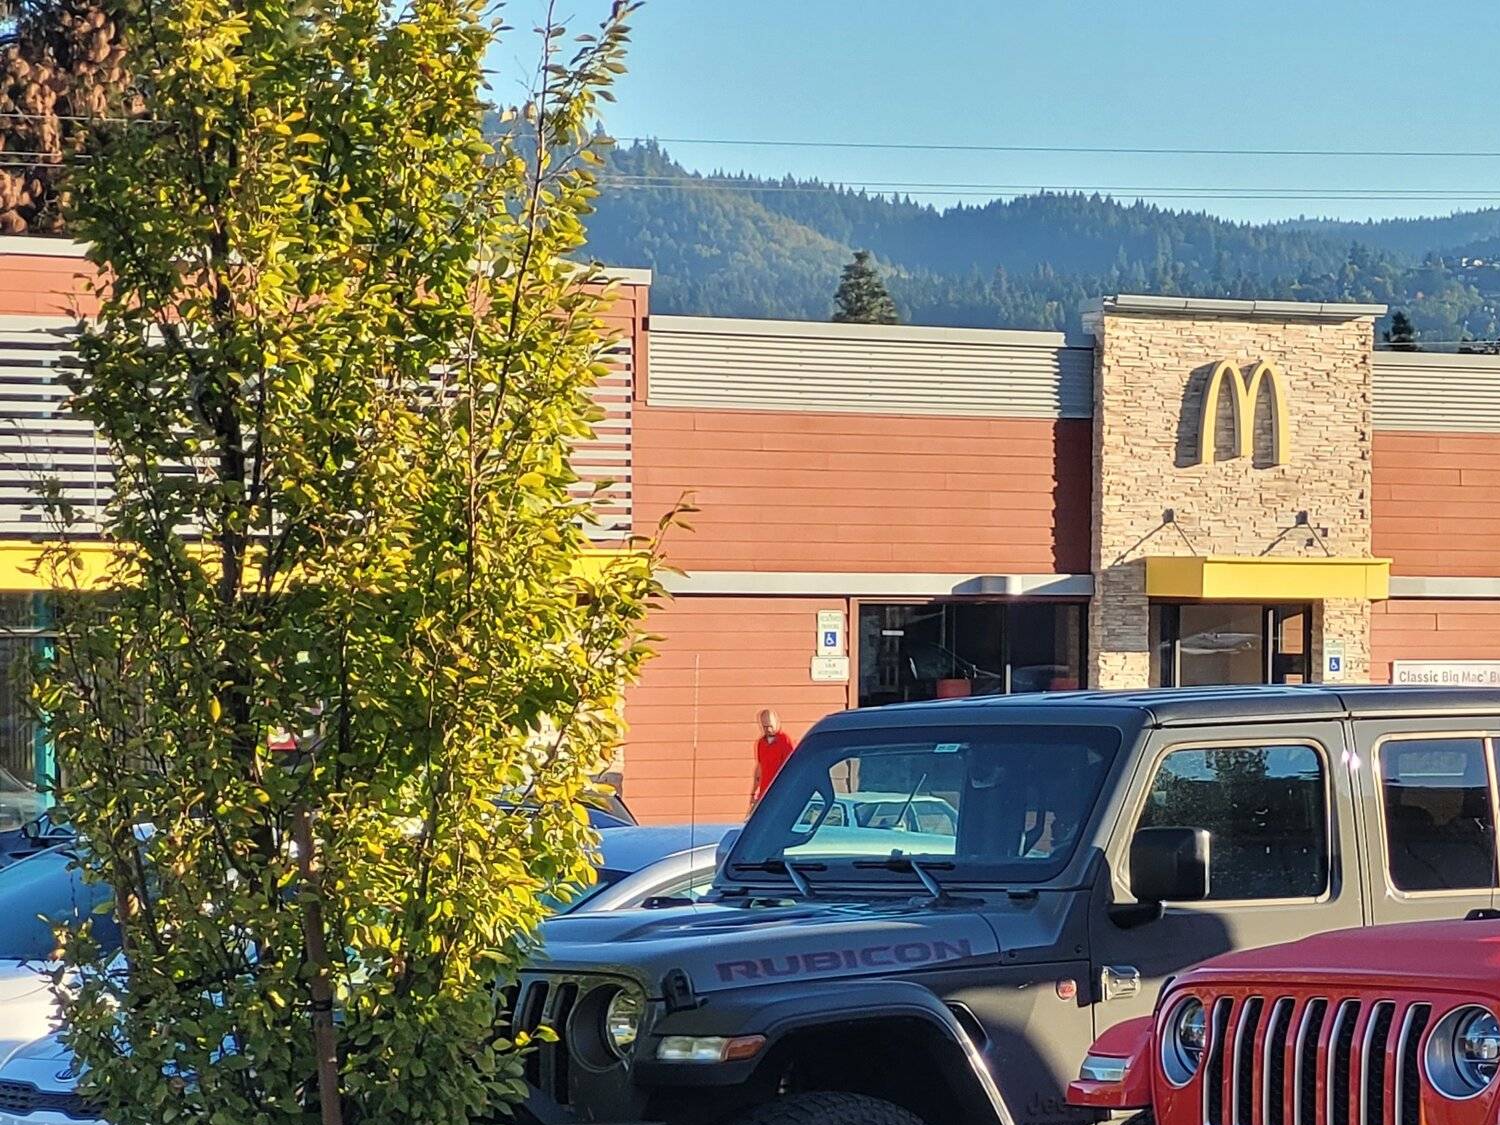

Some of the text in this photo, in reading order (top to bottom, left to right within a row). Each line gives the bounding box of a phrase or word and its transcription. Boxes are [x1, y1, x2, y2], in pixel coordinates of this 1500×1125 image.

[1399, 671, 1438, 683] Classic
[1442, 671, 1459, 684] Big
[715, 937, 972, 982] RUBICON
